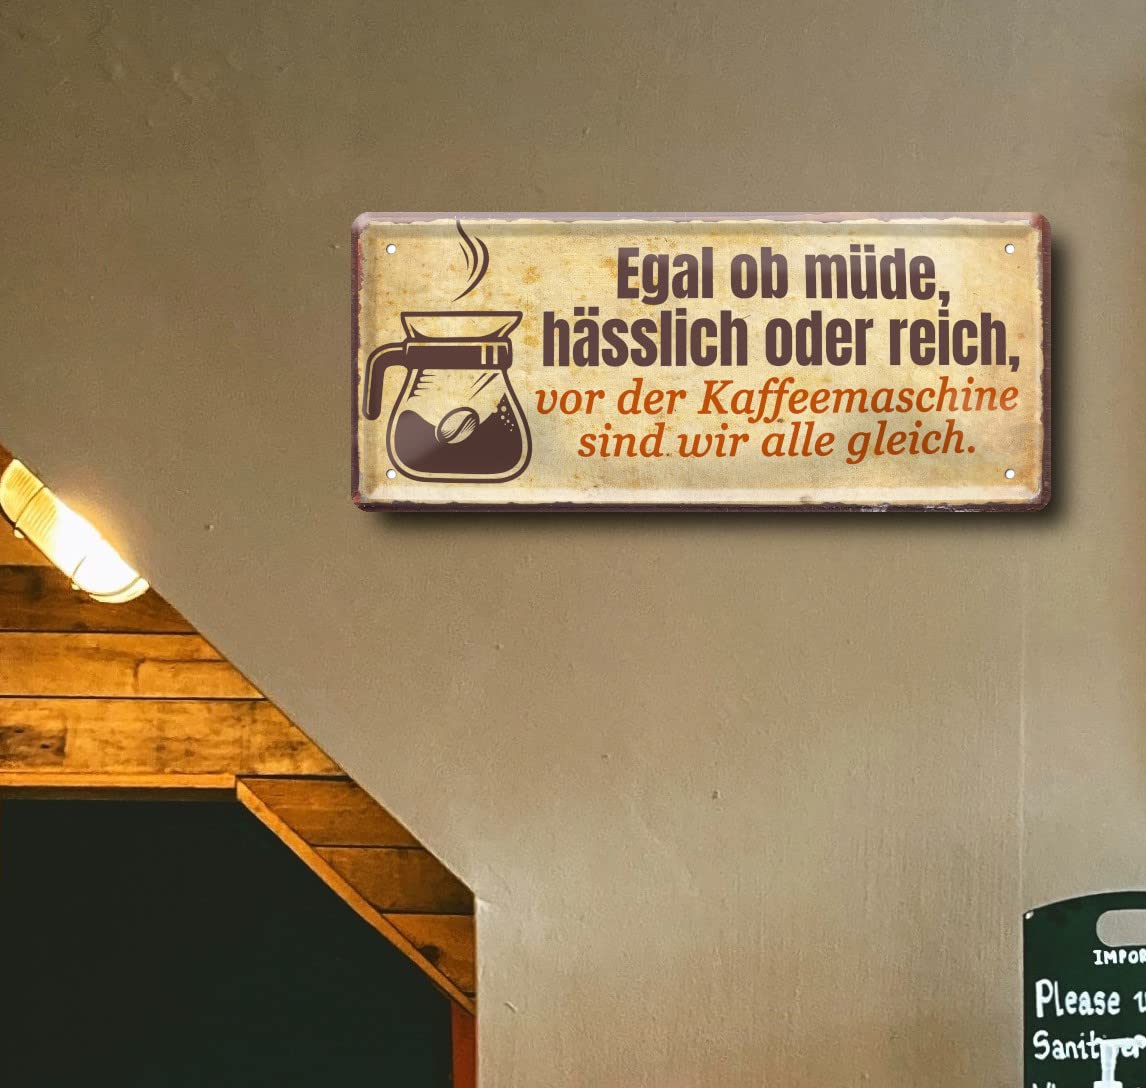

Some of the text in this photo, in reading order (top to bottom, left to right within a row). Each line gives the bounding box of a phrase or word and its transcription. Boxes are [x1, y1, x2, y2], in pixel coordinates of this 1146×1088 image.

[617, 244, 950, 308] Egal ob müde,
[542, 307, 1020, 372] hässlich oder reich,
[536, 376, 1018, 424] vor der Kaffeemaschine
[577, 417, 976, 465] sind wir alle gleich.
[1035, 978, 1121, 1018] Please
